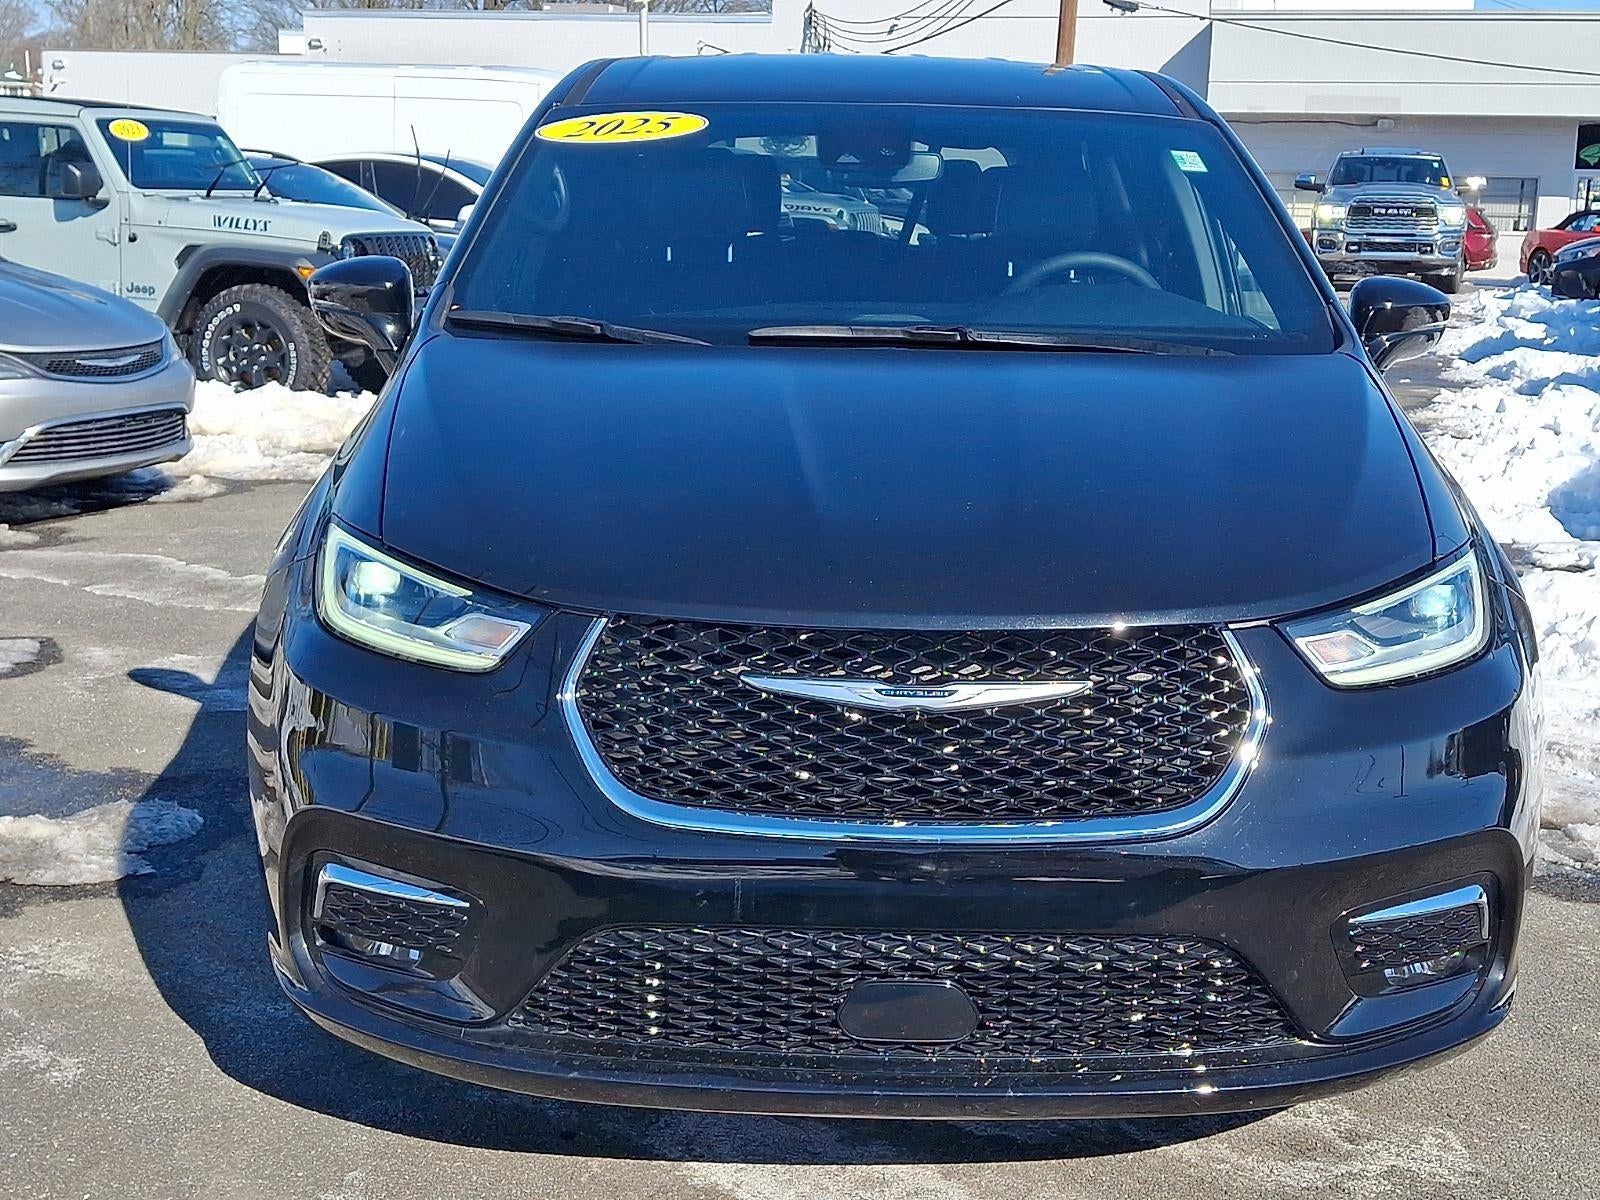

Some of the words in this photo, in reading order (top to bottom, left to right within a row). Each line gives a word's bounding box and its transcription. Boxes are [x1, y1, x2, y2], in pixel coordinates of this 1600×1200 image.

[563, 116, 681, 138] 2025
[784, 203, 833, 213] OJAVE
[1373, 206, 1412, 216] RAM
[213, 214, 272, 232] WILLYS
[125, 281, 156, 297] Jeep
[881, 689, 949, 697] CHRYSLER
